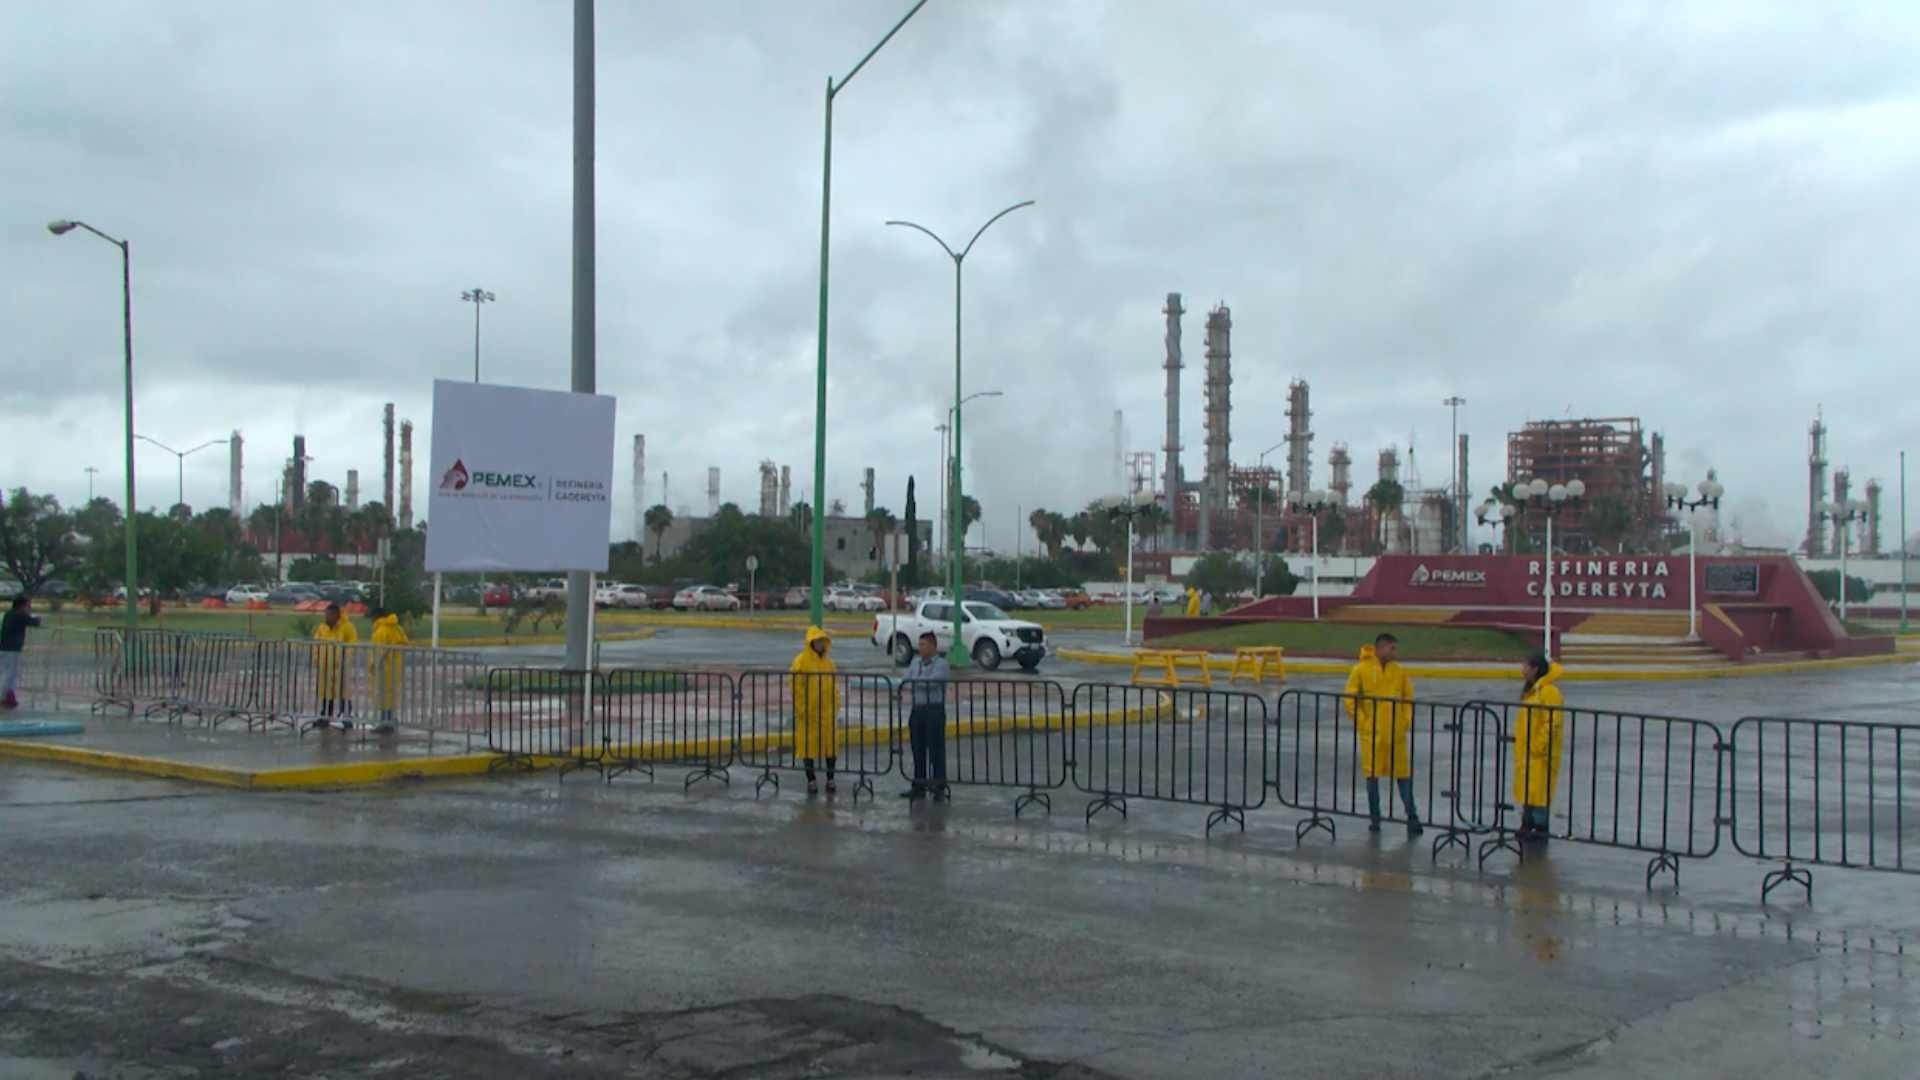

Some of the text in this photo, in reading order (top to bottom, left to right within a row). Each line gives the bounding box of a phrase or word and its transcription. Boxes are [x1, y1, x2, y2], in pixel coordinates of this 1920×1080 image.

[472, 472, 536, 488] PEMEX
[1432, 569, 1486, 581] PEMEX
[1529, 561, 1668, 576] REFINERIA
[1527, 581, 1666, 598] CADEREYTA
